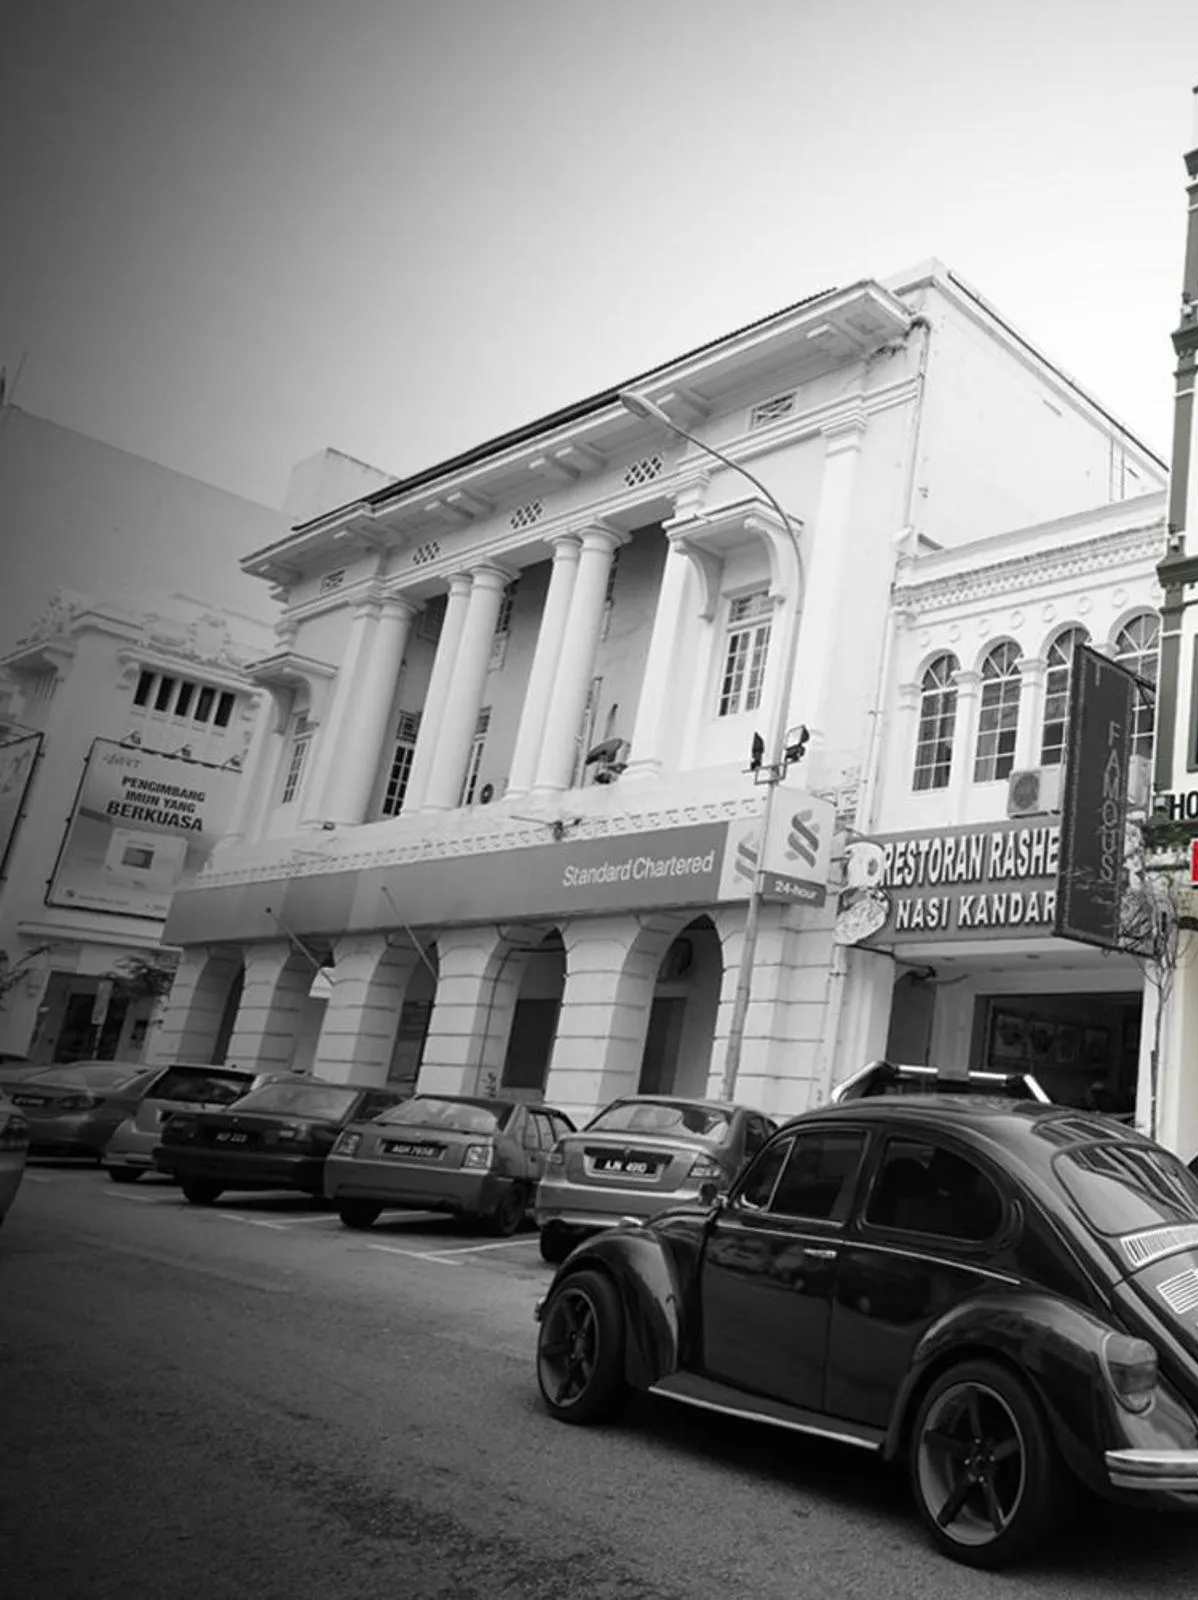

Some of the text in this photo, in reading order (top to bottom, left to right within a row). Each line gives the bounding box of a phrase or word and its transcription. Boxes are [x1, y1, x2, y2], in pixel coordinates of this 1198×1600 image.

[106, 800, 203, 832] BERKUASA
[125, 790, 196, 814] IMUN YANG
[1101, 720, 1123, 882] FAMOUS
[562, 850, 715, 887] Standard Chartered
[881, 833, 986, 888] RESTORAN
[774, 880, 818, 899] 24-hour
[895, 889, 1058, 930] NASI KANDAR
